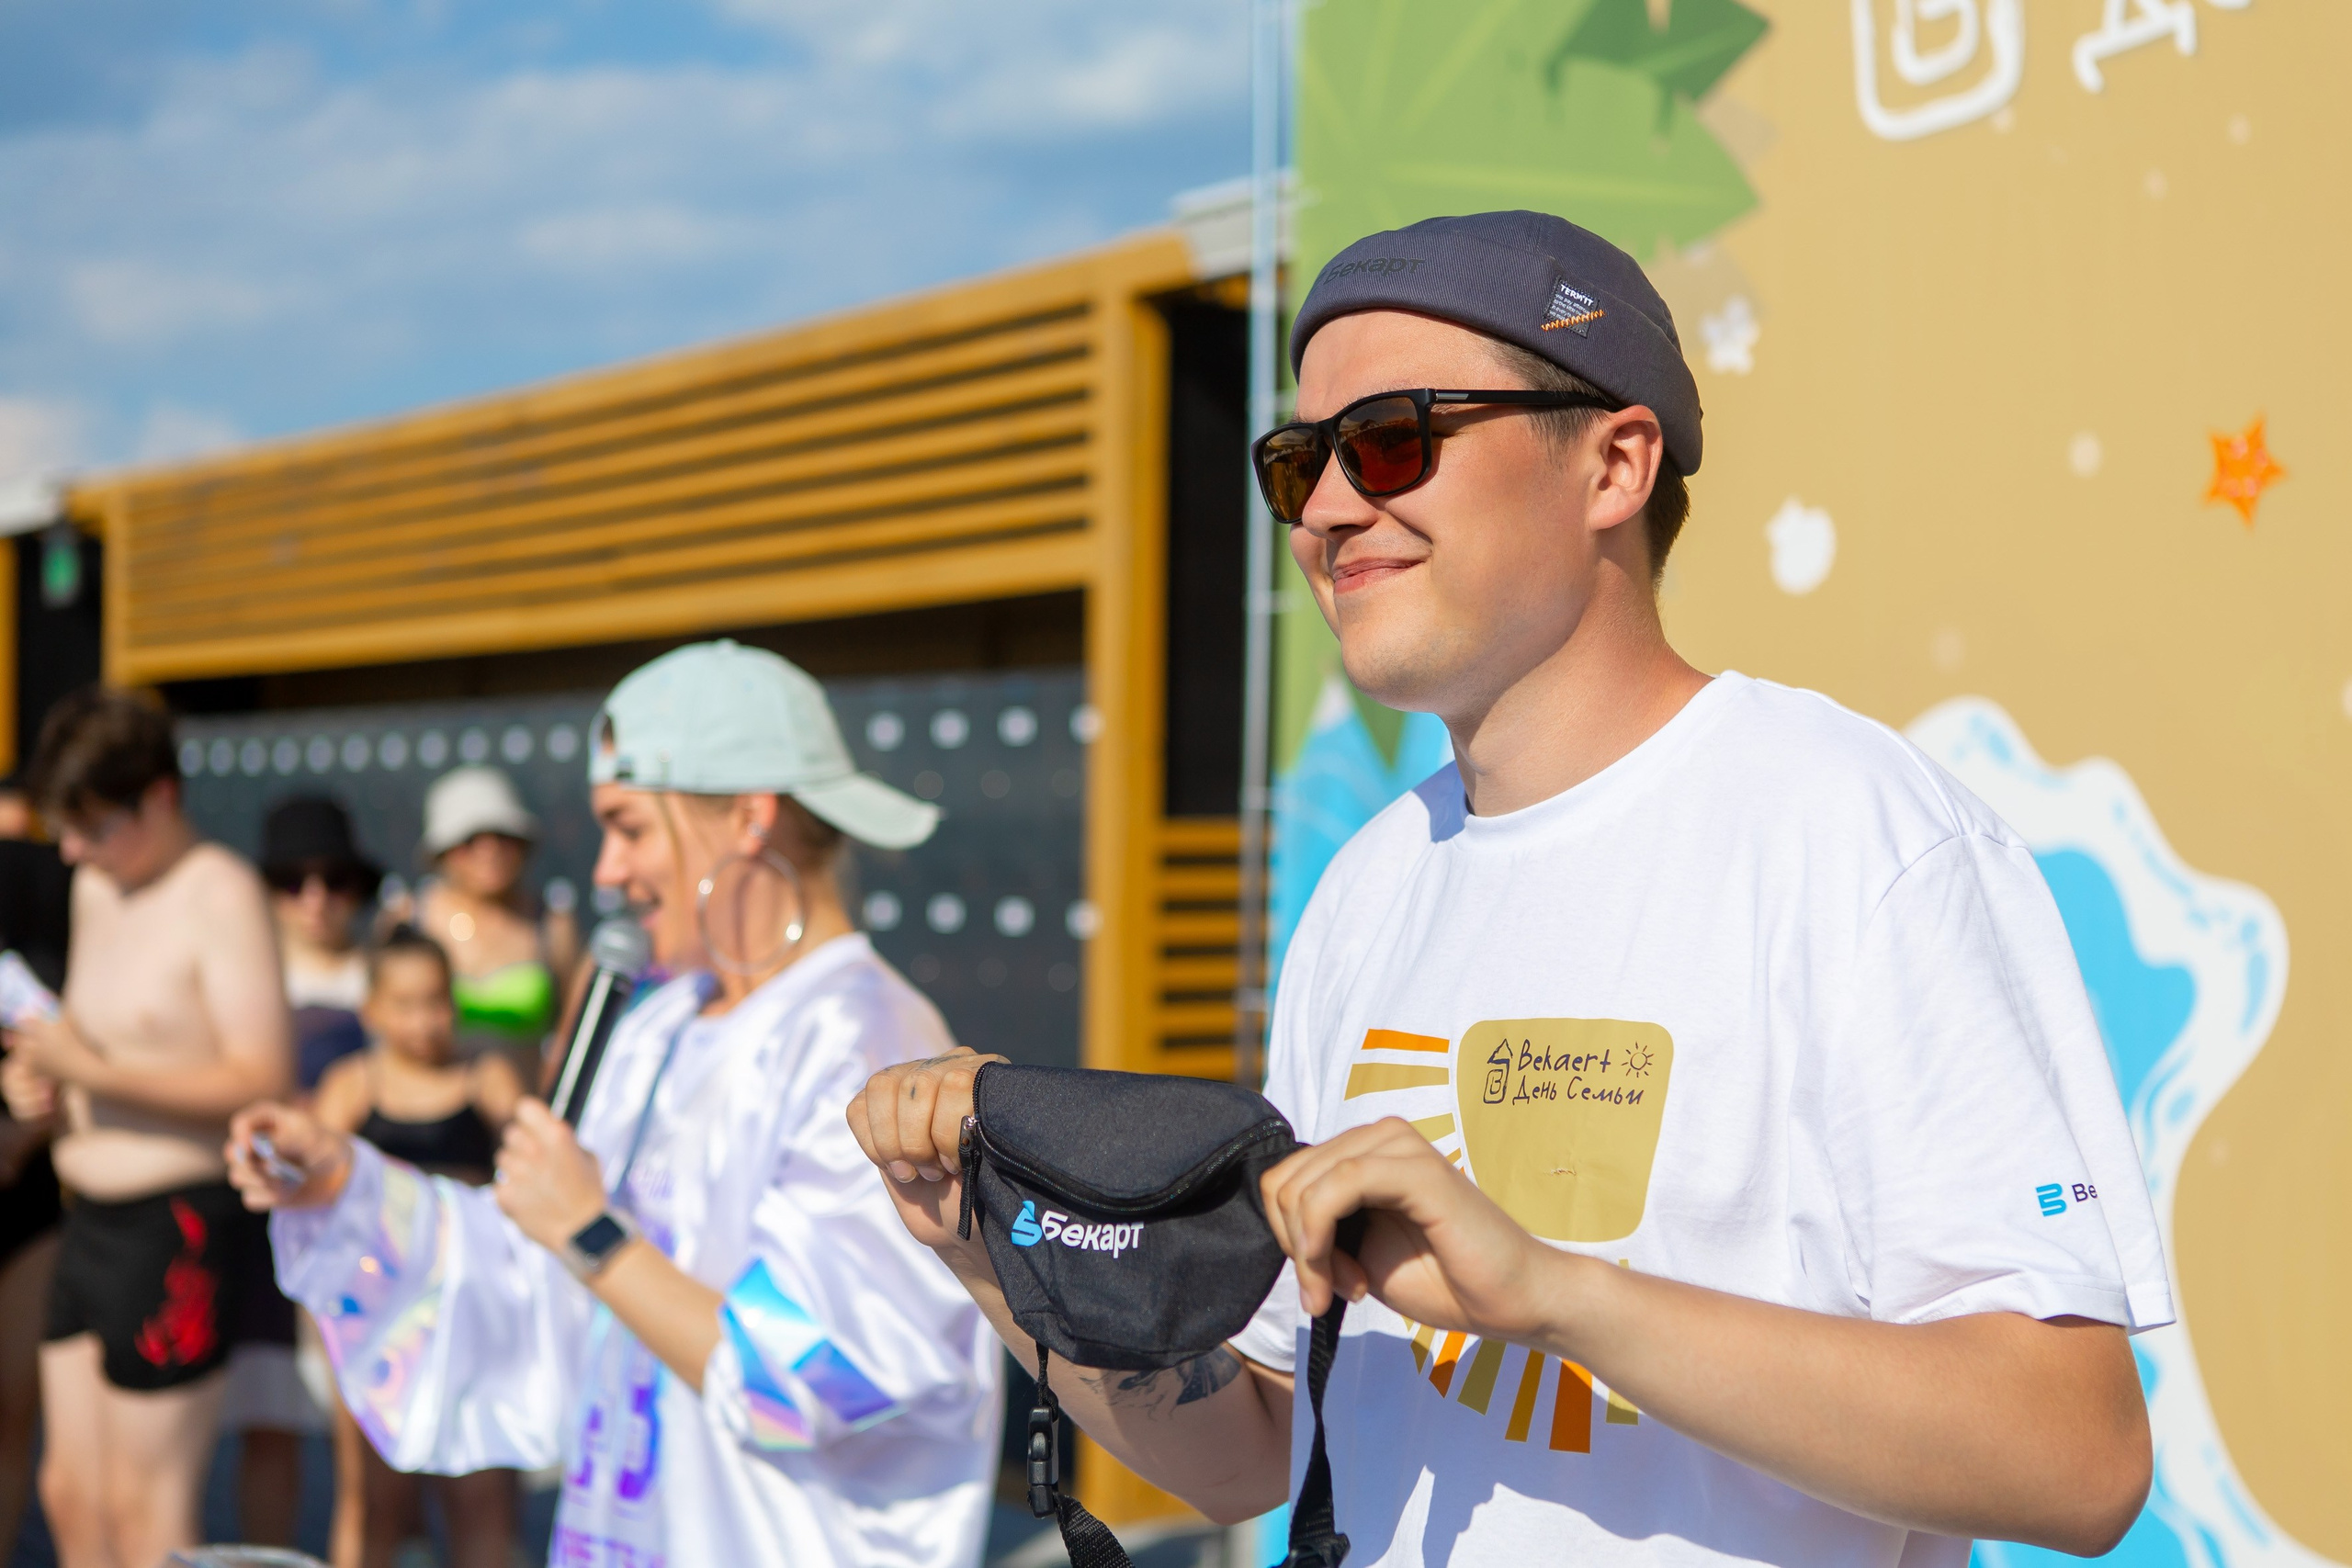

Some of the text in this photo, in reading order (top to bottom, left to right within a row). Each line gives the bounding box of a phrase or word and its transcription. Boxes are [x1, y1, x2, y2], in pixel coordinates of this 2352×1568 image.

[1323, 258, 1426, 285] Бекарт
[1518, 1039, 1611, 1073] Bekaert
[1512, 1075, 1645, 1105] День Семьи
[1041, 1210, 1144, 1259] Бекарт
